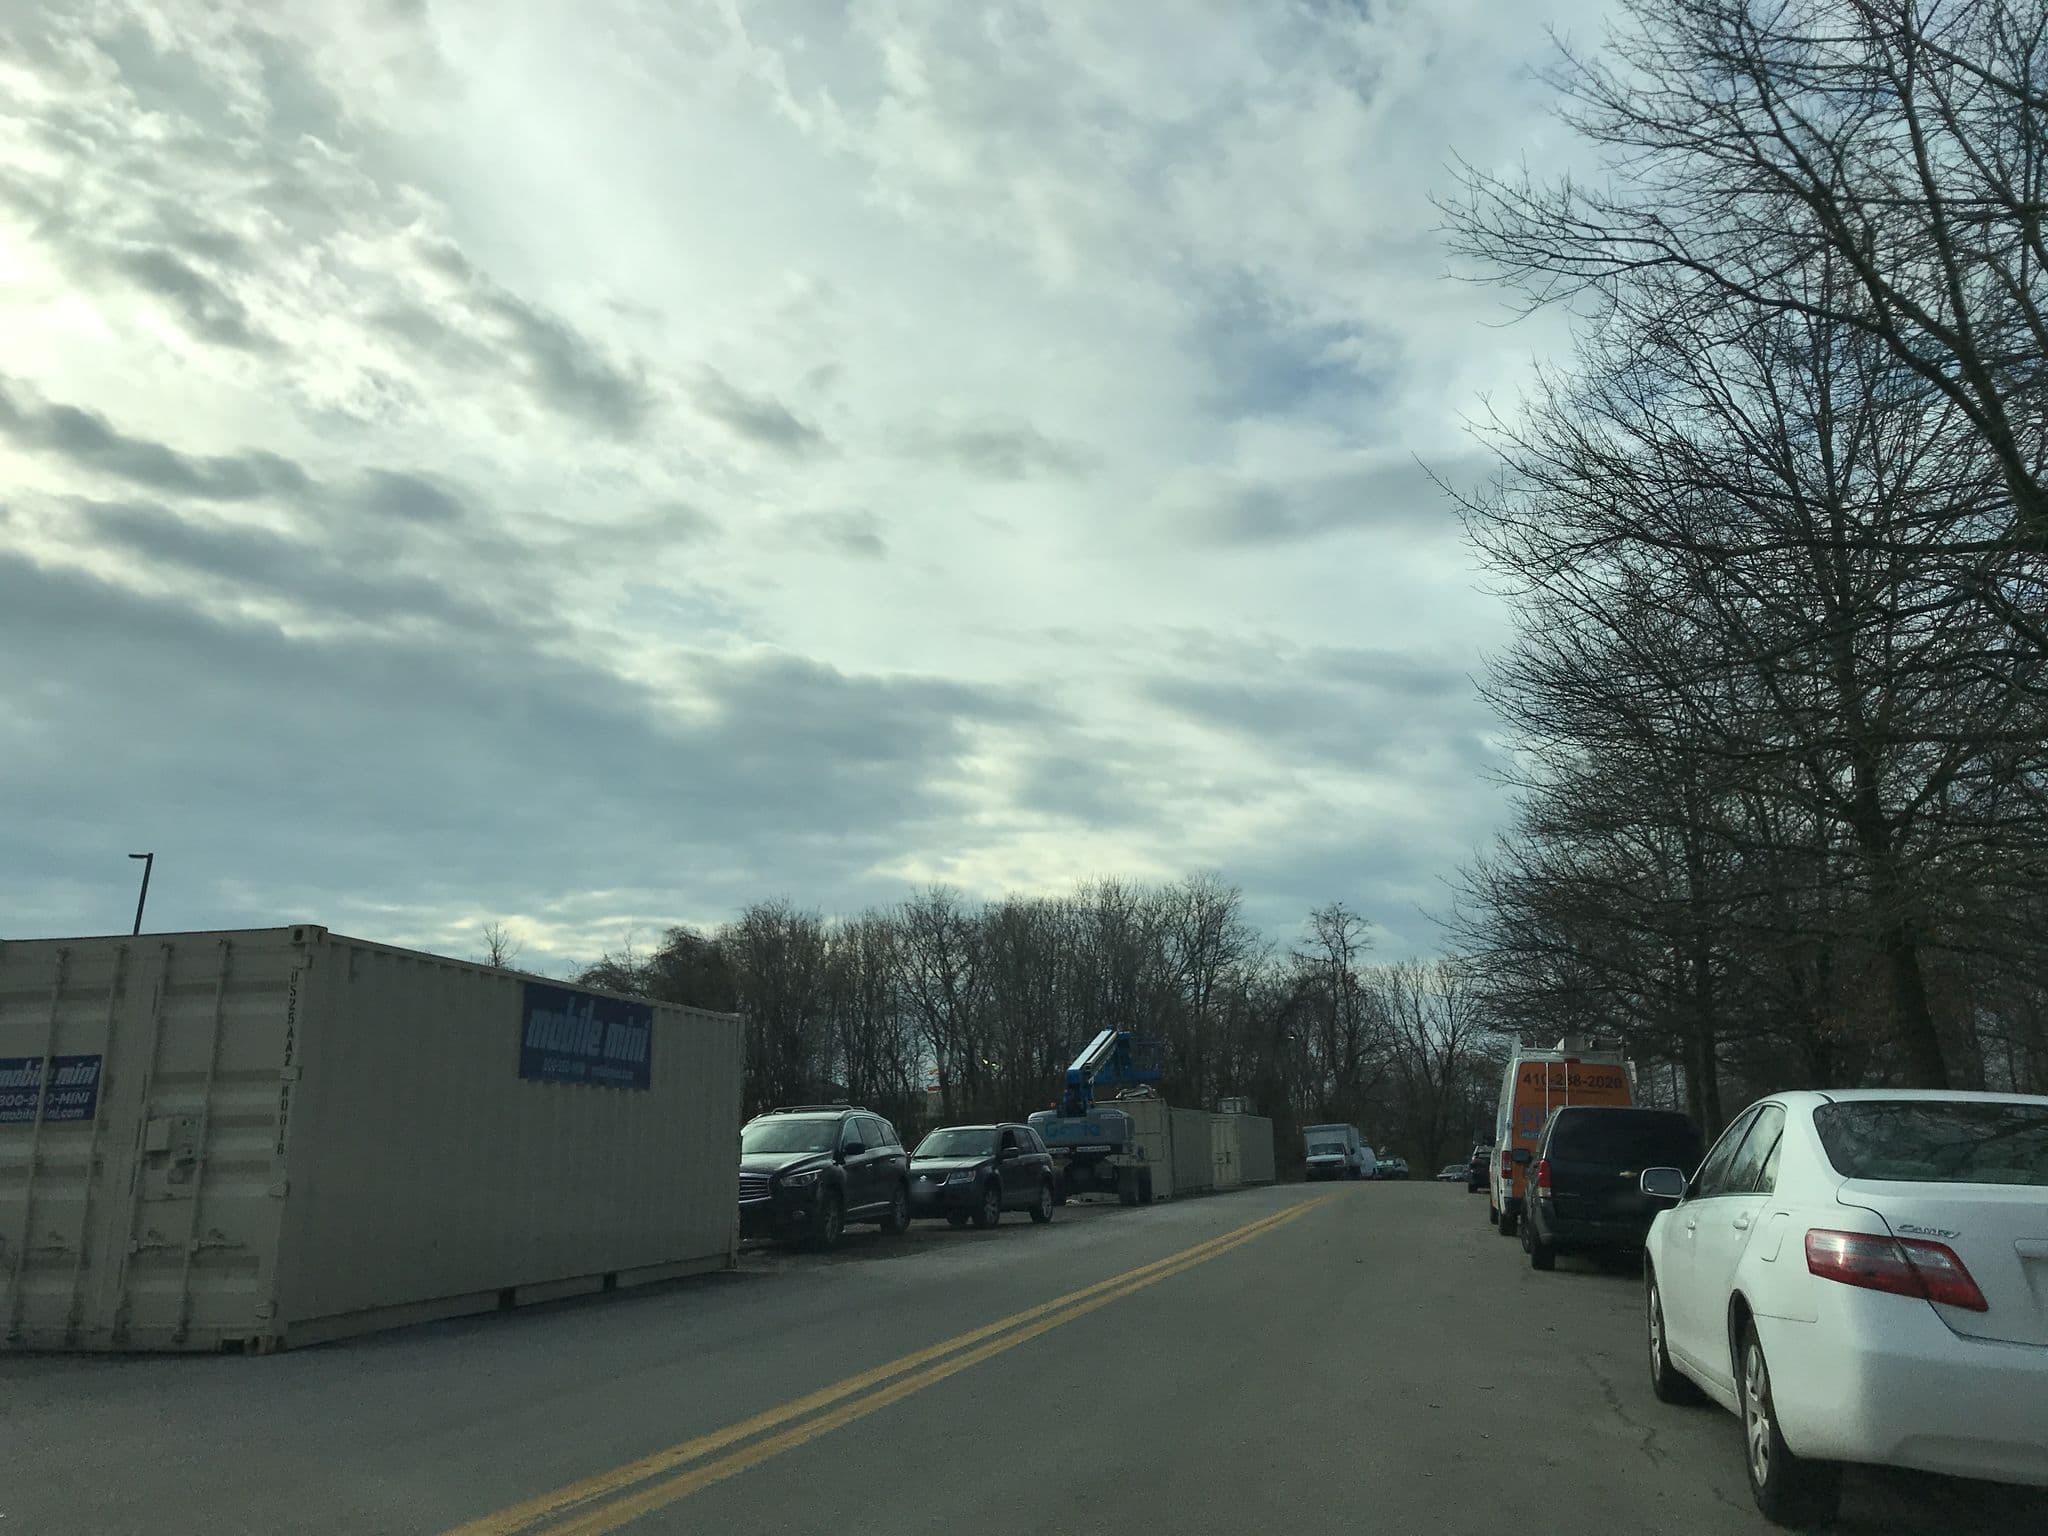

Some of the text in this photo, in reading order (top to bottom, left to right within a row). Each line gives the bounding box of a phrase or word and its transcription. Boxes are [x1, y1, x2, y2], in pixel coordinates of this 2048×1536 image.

[526, 995, 651, 1062] mobile mini
[0, 1060, 100, 1087] mobie mini
[0, 1092, 91, 1106] 800-90-MINI
